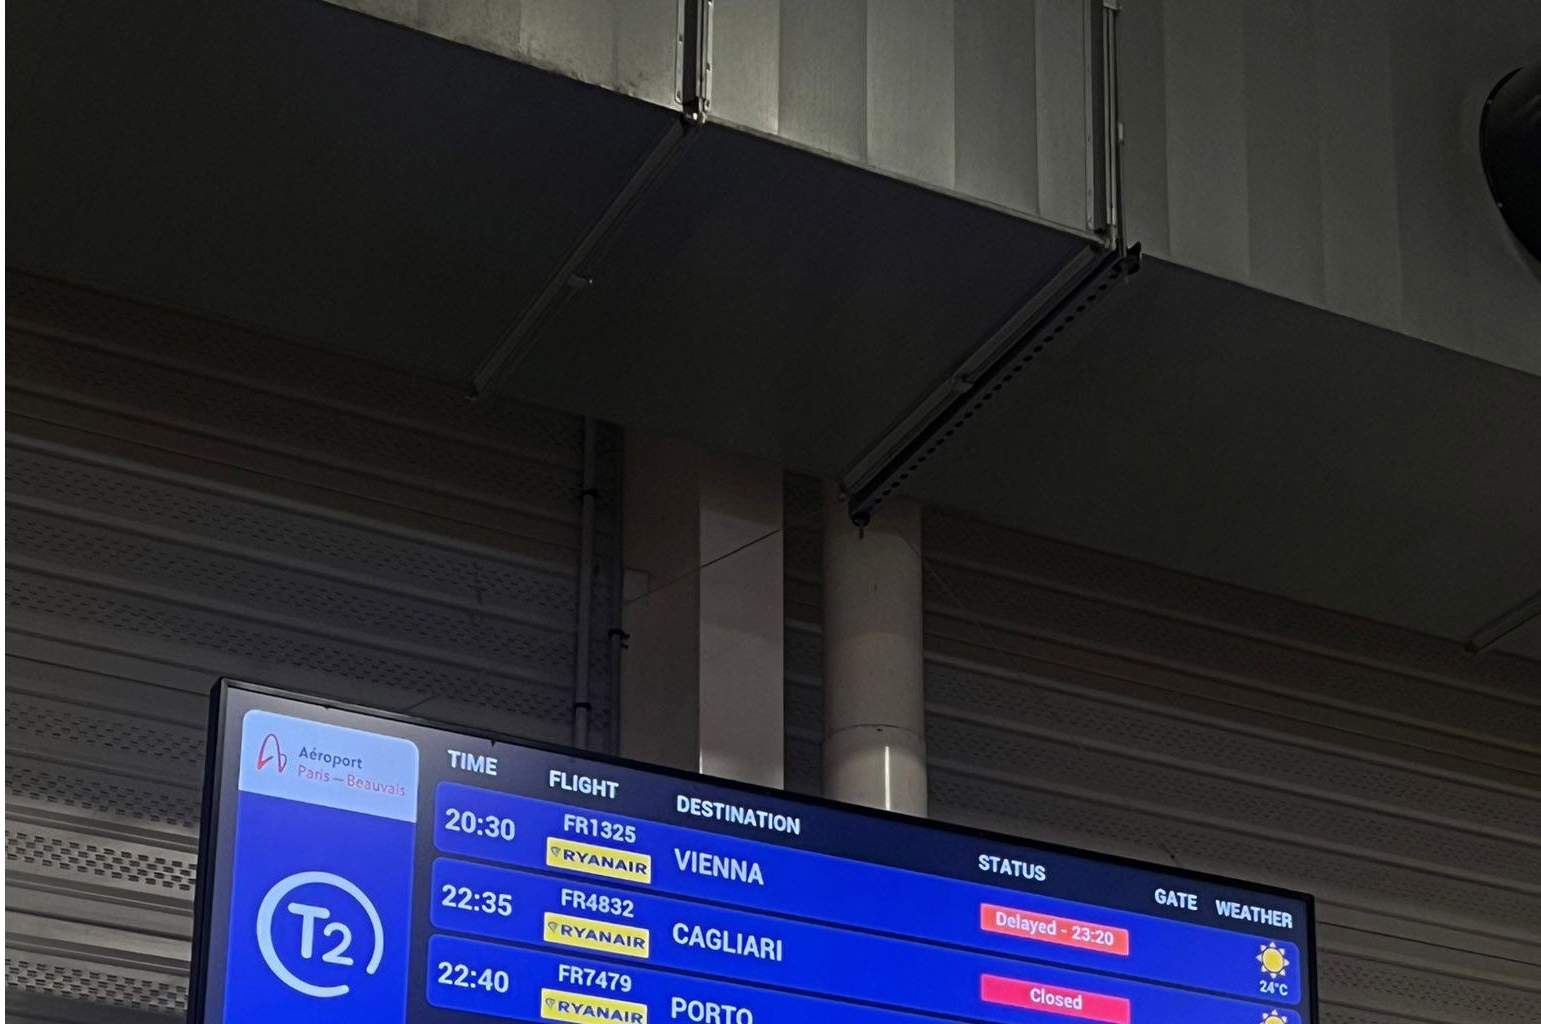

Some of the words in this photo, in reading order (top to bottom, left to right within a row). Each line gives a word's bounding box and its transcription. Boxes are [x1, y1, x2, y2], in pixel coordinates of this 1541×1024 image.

[299, 746, 363, 769] Aéroport
[447, 749, 498, 776] TIME
[298, 764, 331, 783] Paris
[347, 774, 406, 797] Beauvais
[549, 769, 619, 799] FLIGHT
[445, 808, 516, 841] 20:30
[563, 813, 637, 844] FR1325
[676, 795, 801, 835] DESTINATION
[563, 849, 648, 876] RYANAIR
[674, 848, 764, 886] VIENNA
[978, 854, 1047, 882] STATUS
[441, 884, 513, 917] 22:35
[561, 888, 635, 918] FR4832
[1154, 888, 1199, 911] GATE
[1215, 900, 1294, 928] WEATHER
[287, 902, 354, 966] T2
[561, 926, 646, 949] RYANAIR
[672, 922, 783, 962] CAGLIARI
[995, 911, 1057, 936] Delayed
[1071, 925, 1115, 947] 23:20
[437, 961, 510, 993] 22:40
[558, 963, 632, 993] FR7479
[1259, 979, 1289, 996] 24°C
[557, 1001, 644, 1024] RYANAIR
[1030, 987, 1083, 1010] Closed
